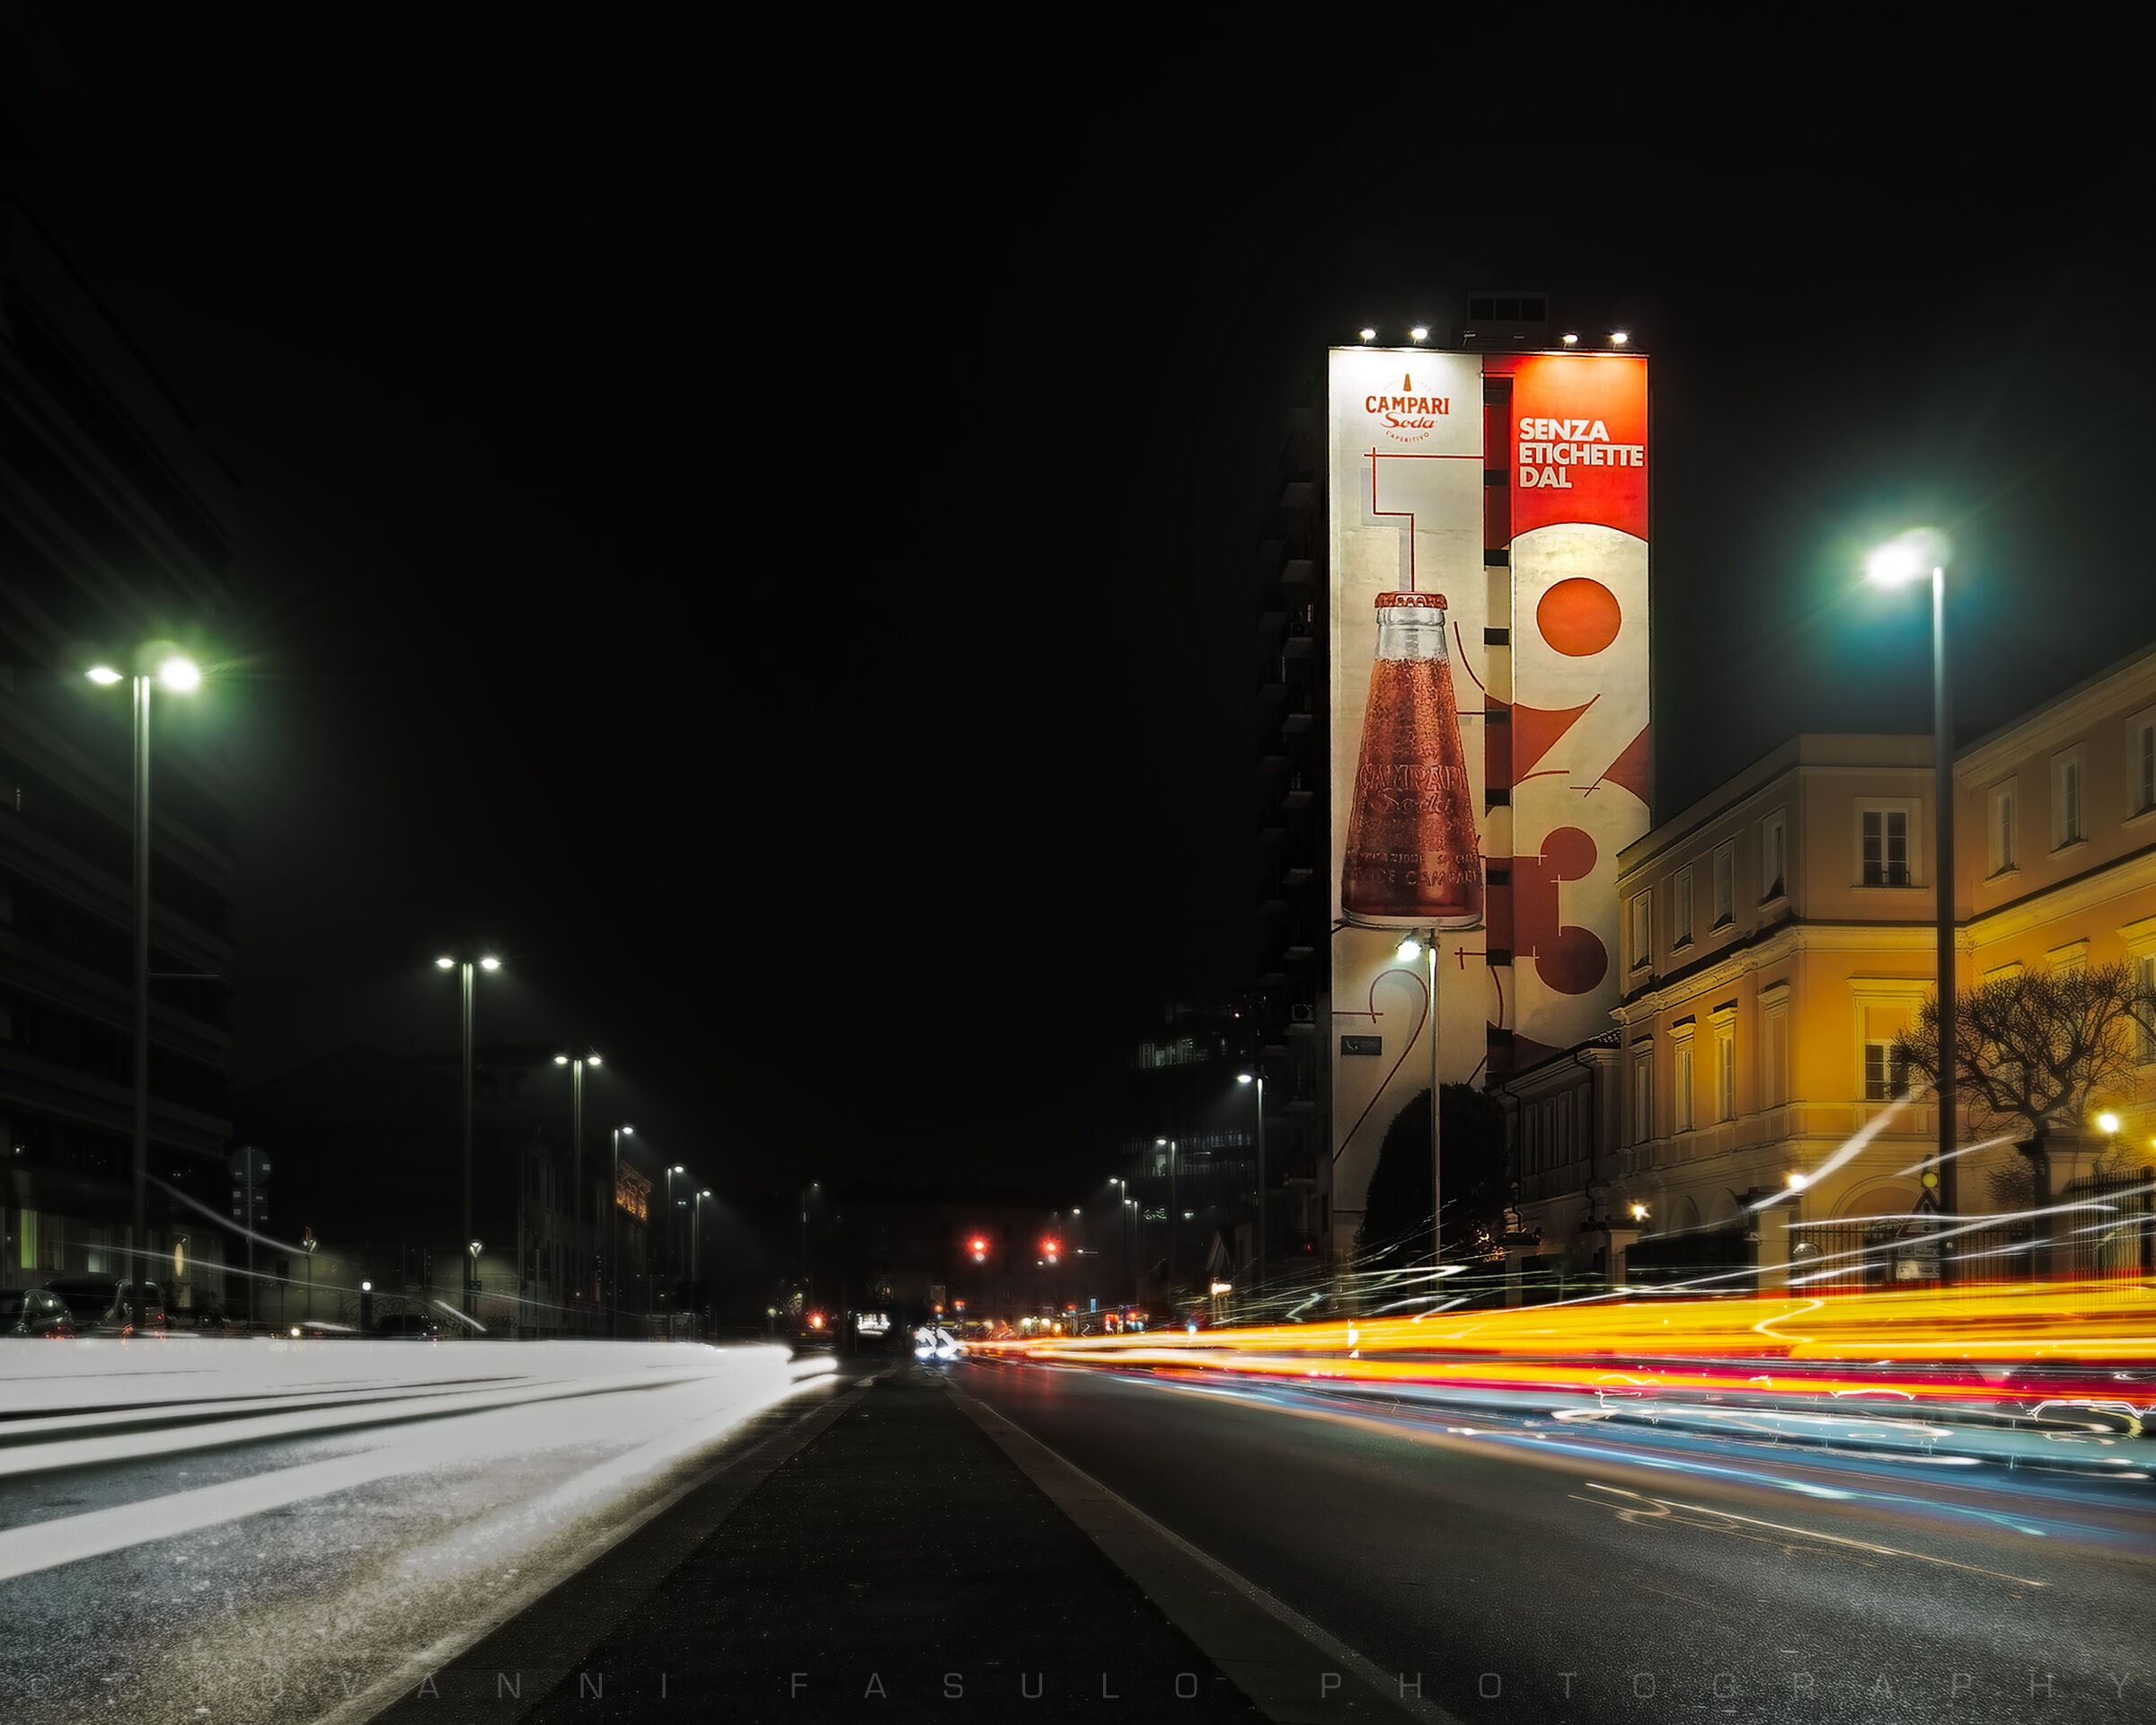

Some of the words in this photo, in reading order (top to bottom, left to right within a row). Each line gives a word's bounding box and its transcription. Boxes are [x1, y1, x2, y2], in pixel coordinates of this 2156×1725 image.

[1365, 395, 1450, 415] CAMPARI
[1380, 411, 1436, 429] Soda
[1519, 417, 1610, 442] SENZA
[1519, 441, 1645, 467] ETICHETTE
[1519, 465, 1573, 489] DAL
